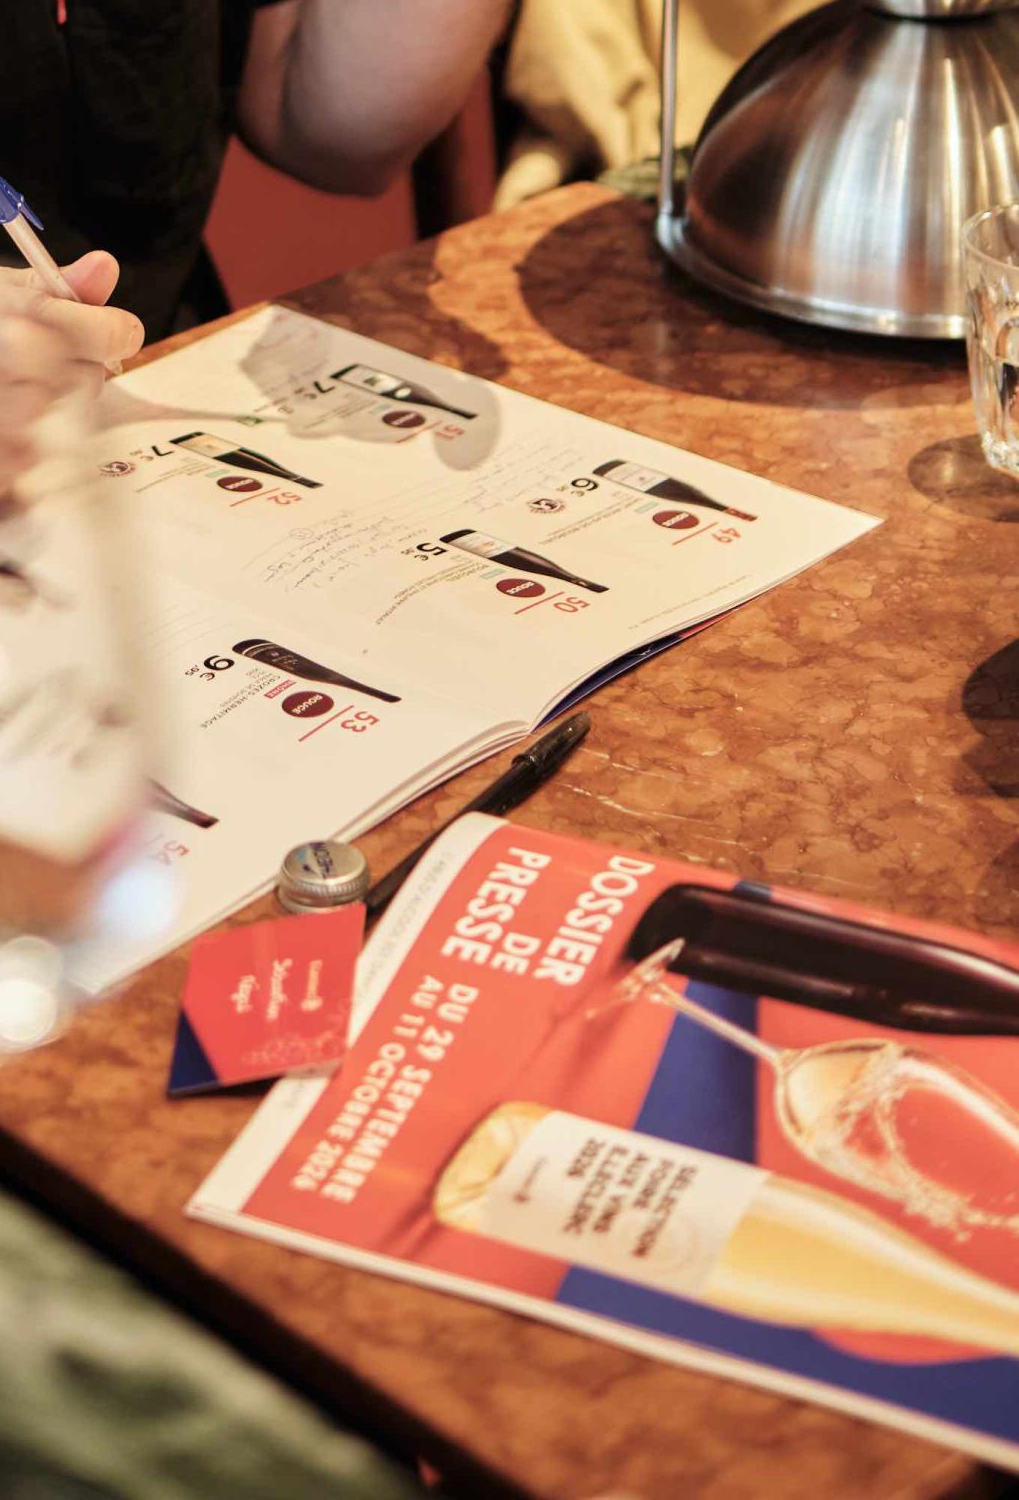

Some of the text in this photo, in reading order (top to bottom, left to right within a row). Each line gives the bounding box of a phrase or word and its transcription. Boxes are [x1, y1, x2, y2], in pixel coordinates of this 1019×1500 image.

[267, 491, 304, 506] 52
[712, 527, 741, 544] 49
[553, 596, 591, 613] 50
[292, 694, 323, 715] ROUGE
[340, 710, 380, 733] 53
[440, 846, 553, 965] PRESSE
[533, 854, 656, 987] DOSSIER
[489, 931, 542, 977] DE
[411, 974, 444, 1009] AU
[392, 1013, 426, 1039] 11
[320, 983, 480, 1204] DU 29 SEPTEMBRE
[327, 1042, 407, 1142] OCTOBRE
